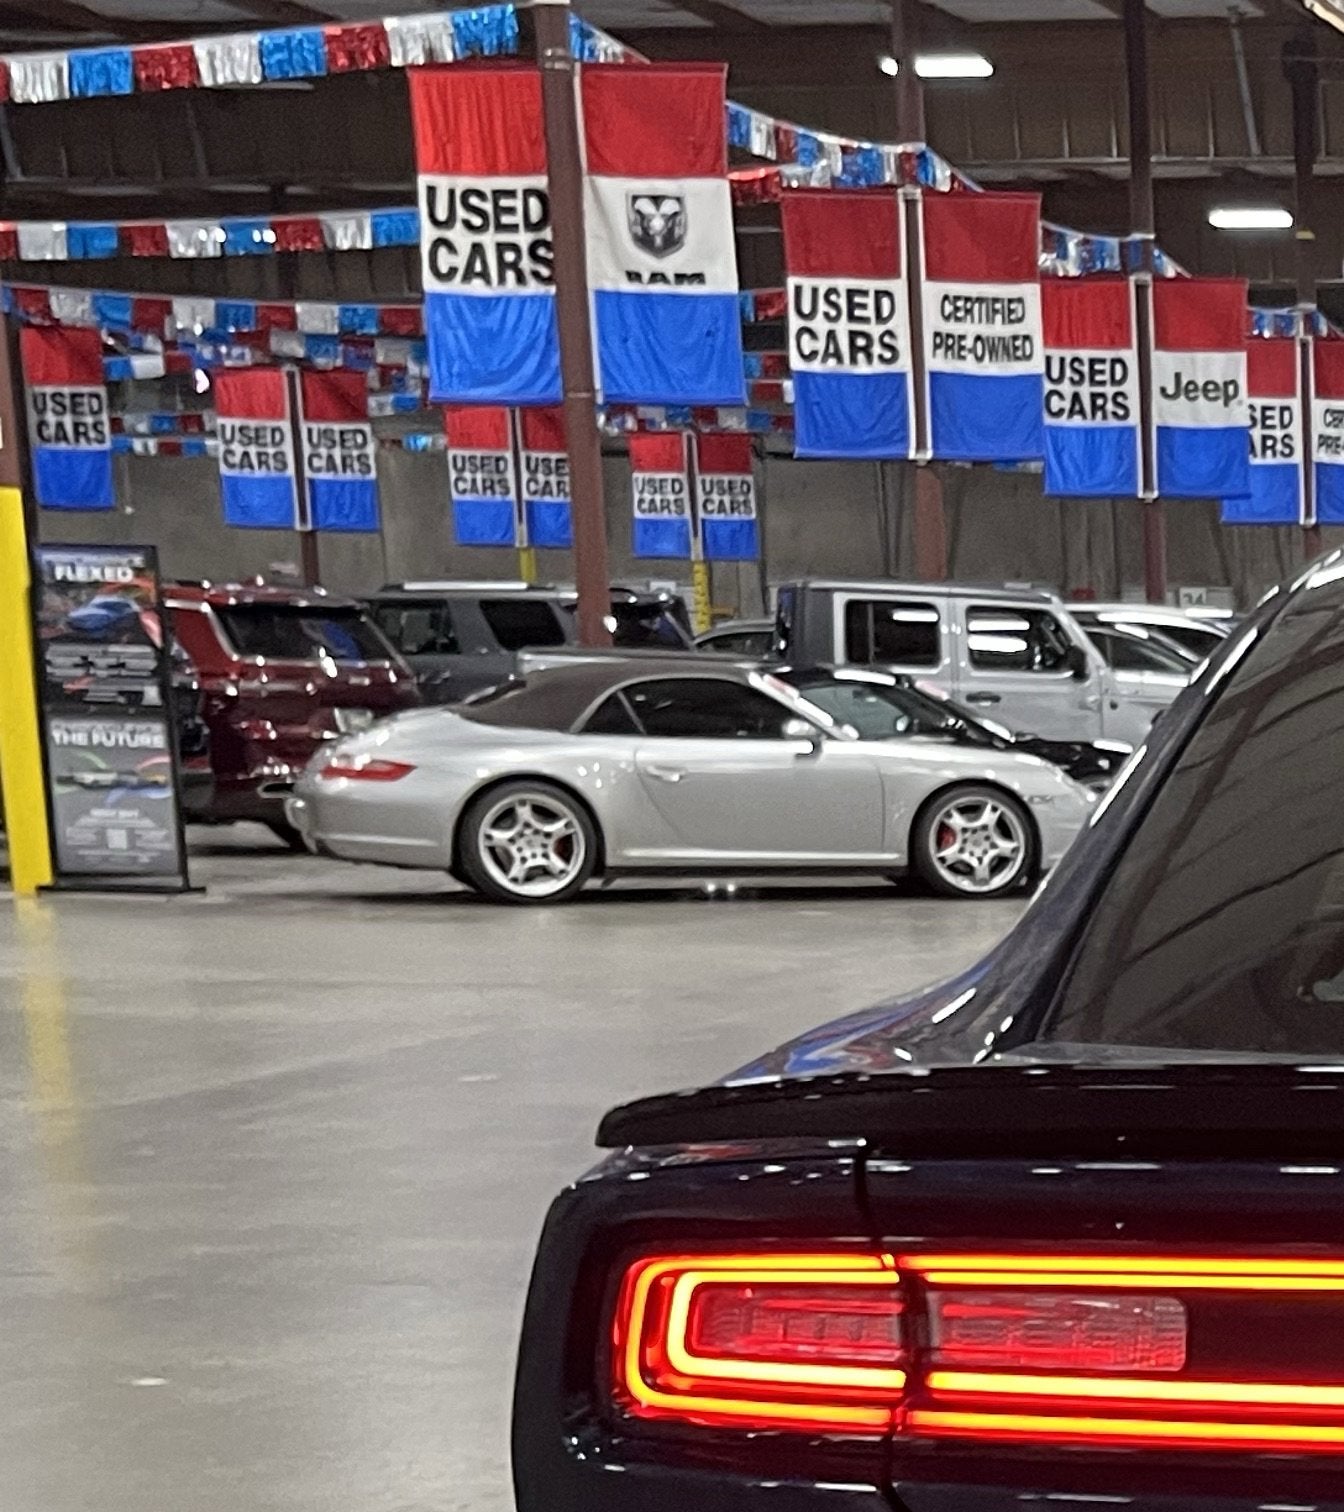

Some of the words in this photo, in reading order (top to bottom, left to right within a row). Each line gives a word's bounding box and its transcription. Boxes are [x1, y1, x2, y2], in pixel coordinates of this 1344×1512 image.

[426, 185, 550, 233] USED
[427, 237, 554, 286] CARS
[794, 285, 895, 325] USED
[940, 294, 1026, 325] CERTIFIED
[795, 326, 899, 366] CARS
[933, 332, 1033, 362] PRE-OWNED
[1045, 354, 1128, 387] USED
[1160, 372, 1240, 407] Jeep
[32, 391, 103, 417] USED
[1045, 390, 1130, 421] CARS
[36, 416, 106, 445] CARS
[220, 424, 284, 447] USED
[307, 427, 367, 449] USED
[222, 449, 288, 473] CARS
[308, 451, 371, 474] CARS
[452, 455, 508, 475] USED
[526, 456, 568, 476] USE
[453, 476, 511, 497] CARS
[526, 477, 569, 497] CAR
[635, 477, 684, 496] USED
[701, 478, 750, 496] USED
[637, 498, 686, 514] CARS
[702, 497, 753, 514] CARS
